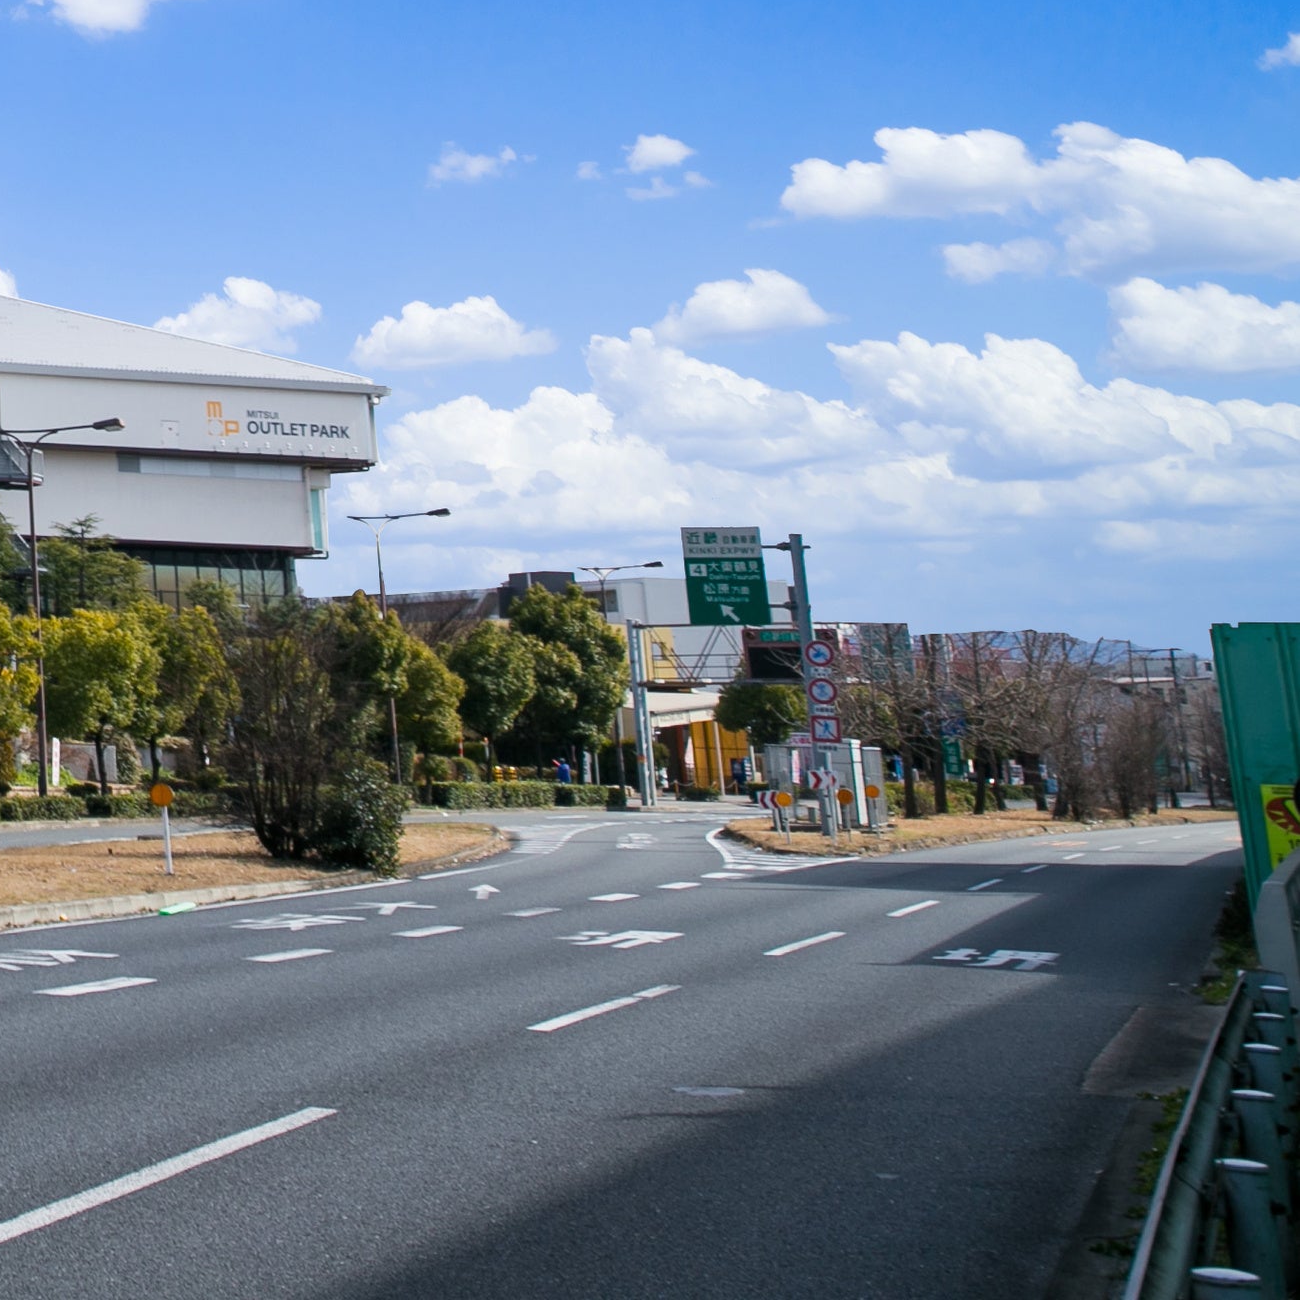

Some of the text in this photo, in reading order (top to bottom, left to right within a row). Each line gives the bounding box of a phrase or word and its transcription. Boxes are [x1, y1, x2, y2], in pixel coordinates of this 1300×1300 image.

[246, 410, 280, 420] MITSUI
[247, 420, 350, 439] OUTLET PARK
[688, 547, 756, 555] KINKI EXPWY
